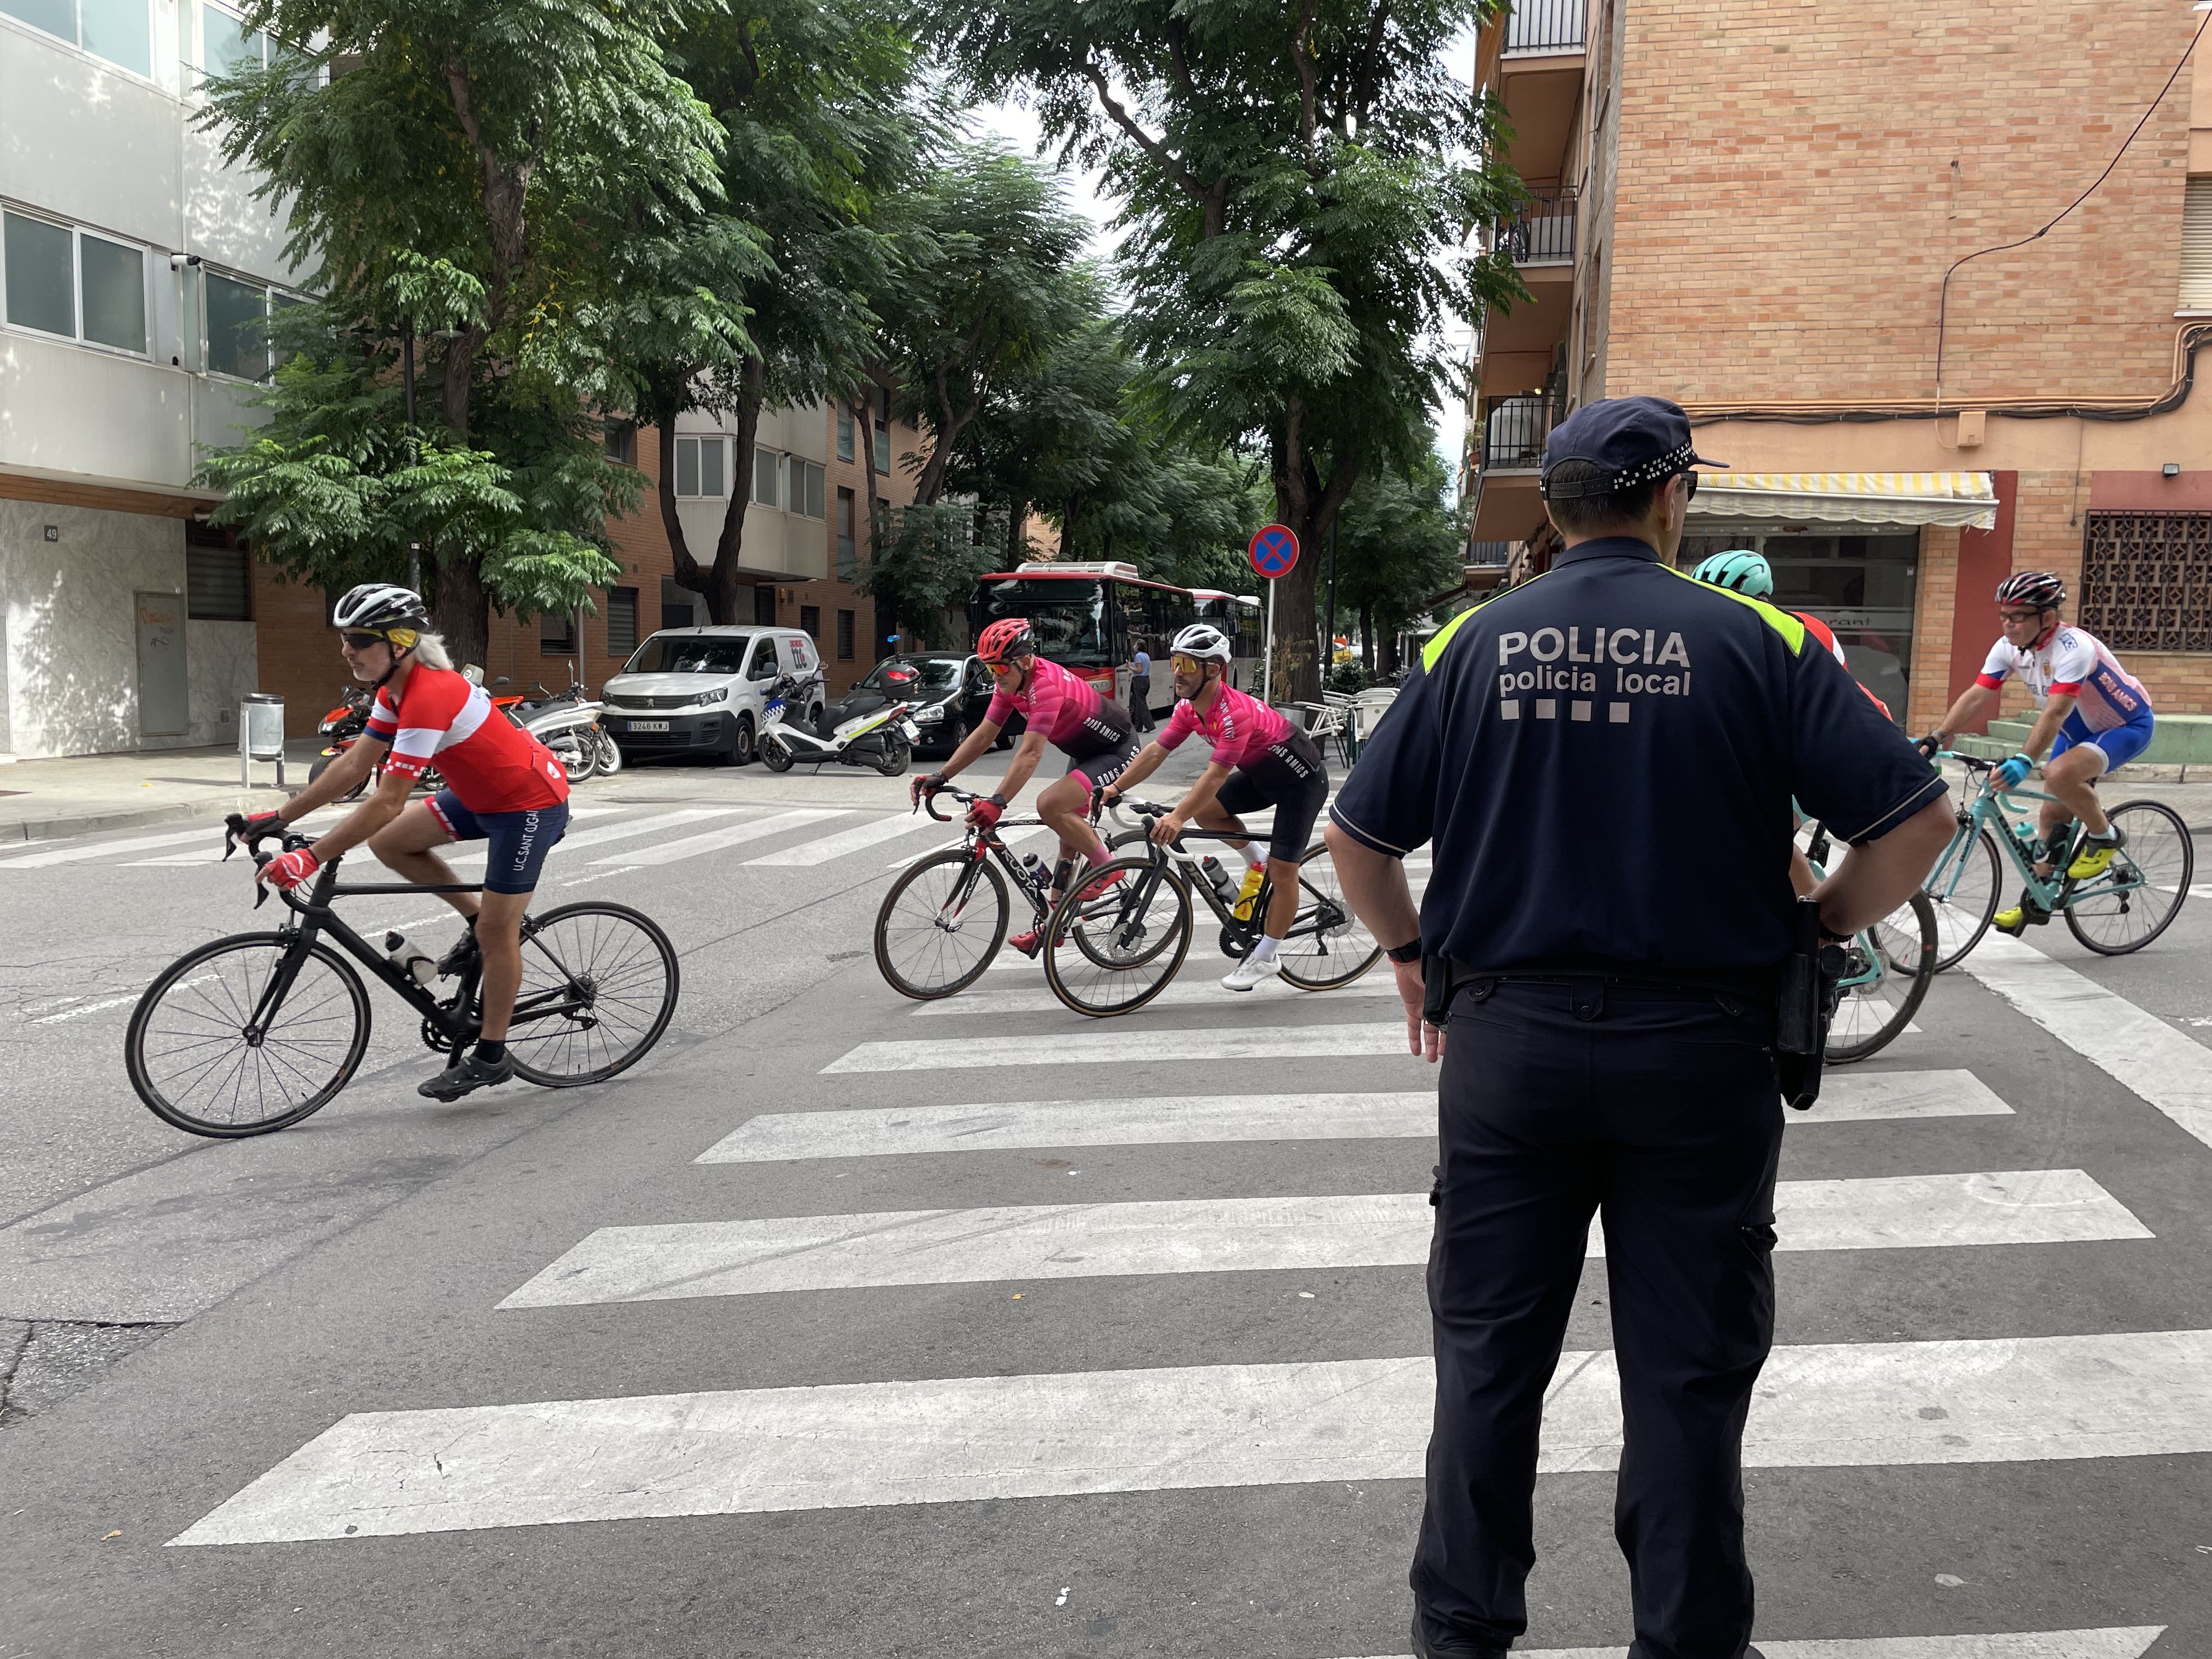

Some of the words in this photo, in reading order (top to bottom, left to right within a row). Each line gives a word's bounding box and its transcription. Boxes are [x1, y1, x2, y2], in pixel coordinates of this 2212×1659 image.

[47, 528, 57, 539] 49
[1499, 627, 1691, 668] POLICIA
[1499, 664, 1596, 697] policia
[1616, 668, 1690, 696] local
[1084, 717, 1102, 731] BONS
[1099, 725, 1120, 742] AMICS
[1097, 768, 1120, 787] BONS
[1285, 755, 1308, 778] AMICS
[512, 834, 535, 871] U.C.SANT
[1001, 849, 1038, 898] KUOTA
[1021, 887, 1041, 911] KREDO
